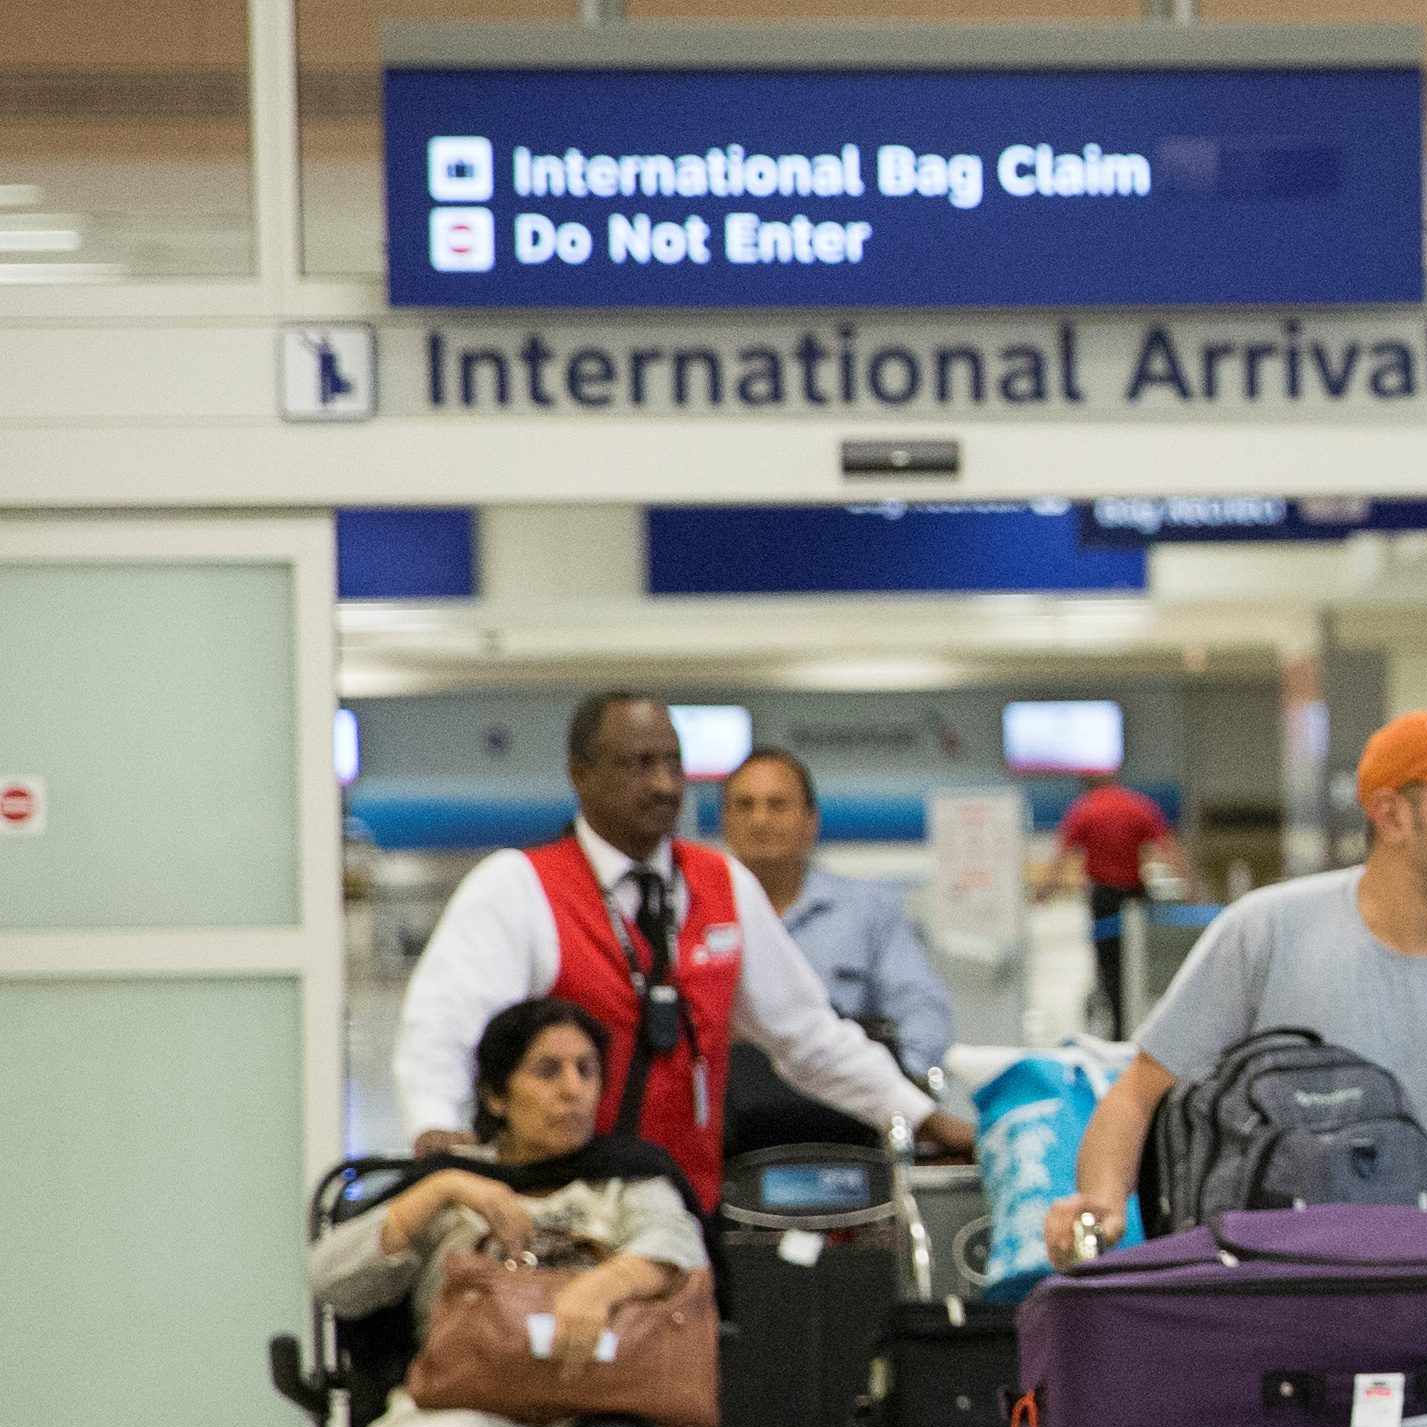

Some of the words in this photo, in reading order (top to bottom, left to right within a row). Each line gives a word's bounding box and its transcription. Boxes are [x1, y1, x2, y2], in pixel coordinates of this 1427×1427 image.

[513, 144, 863, 197] International
[876, 144, 983, 208] Bag
[997, 143, 1151, 196] Claim
[514, 213, 592, 264] Do
[607, 212, 711, 265] Not
[724, 212, 872, 264] Enter
[428, 323, 1086, 408] International
